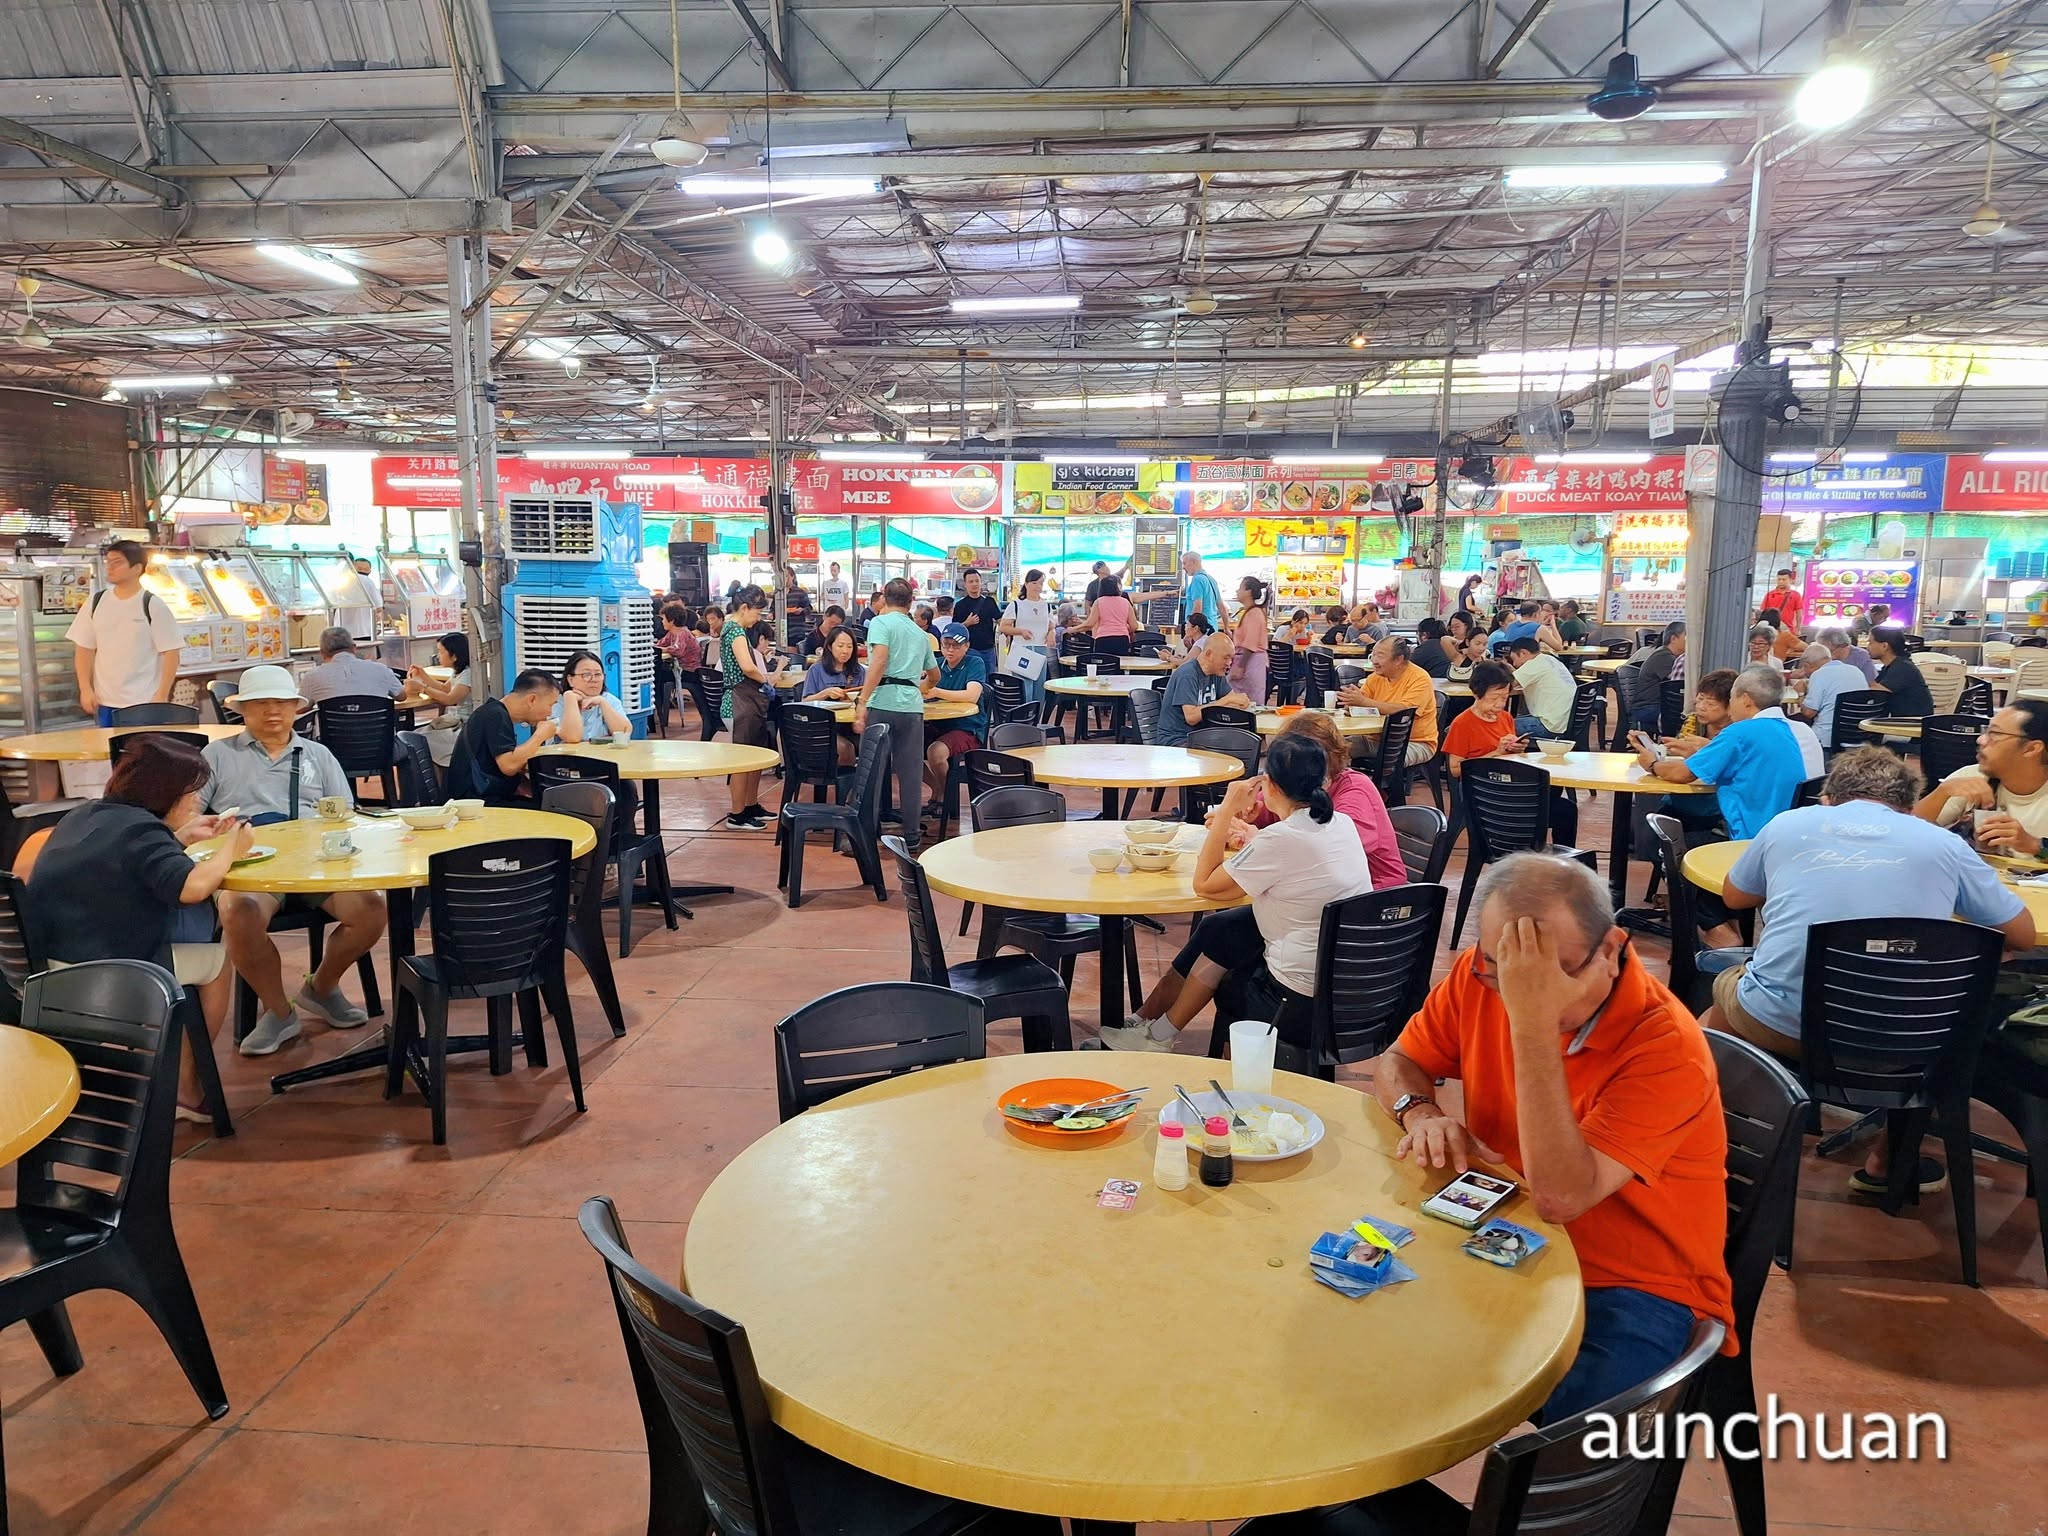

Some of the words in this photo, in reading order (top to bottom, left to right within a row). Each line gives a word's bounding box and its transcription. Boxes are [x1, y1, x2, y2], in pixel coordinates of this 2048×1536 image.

[408, 458, 460, 470] 关丹路咖
[570, 462, 619, 470] KUANTAN
[622, 462, 651, 471] ROAD
[842, 468, 952, 481] HOKKIEN
[1058, 482, 1083, 490] Indian
[1085, 482, 1104, 490] Food
[1106, 482, 1134, 490] Corner
[1959, 470, 2006, 494] ALL
[624, 492, 654, 506] MEE
[702, 494, 761, 508] HOKKIE
[842, 490, 891, 504] MEE
[1516, 493, 1556, 503] DUCK
[1559, 492, 1601, 502] MEAT
[1605, 491, 1643, 502] KOAY
[1804, 491, 1821, 499] Rice
[1823, 491, 1831, 499] &
[1832, 490, 1861, 501] Sizzling
[1863, 490, 1878, 499] Yee
[1879, 490, 1895, 499] Mee
[1896, 489, 1927, 499] Noodles
